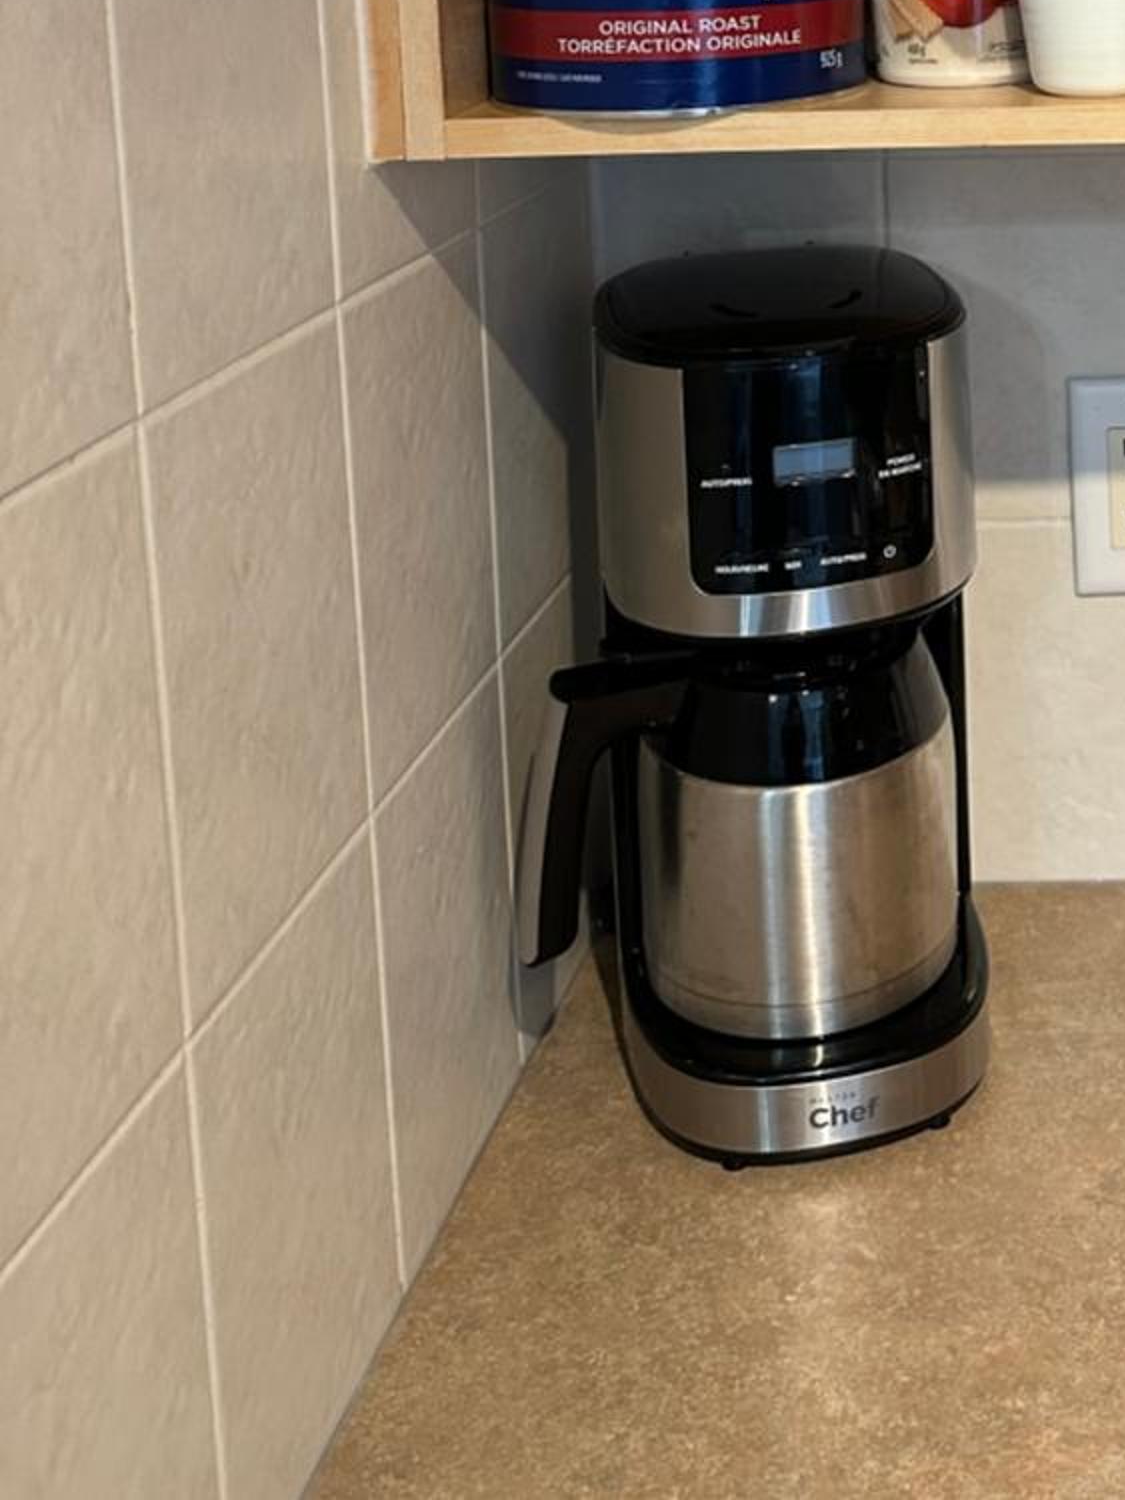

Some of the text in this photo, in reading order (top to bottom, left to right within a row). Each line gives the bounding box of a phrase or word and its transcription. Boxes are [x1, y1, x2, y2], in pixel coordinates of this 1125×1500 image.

[599, 14, 763, 36] ORIGINAL ROAST
[558, 28, 802, 54] TORRÉFACTION ORIGINALE
[809, 1095, 881, 1129] Chef
